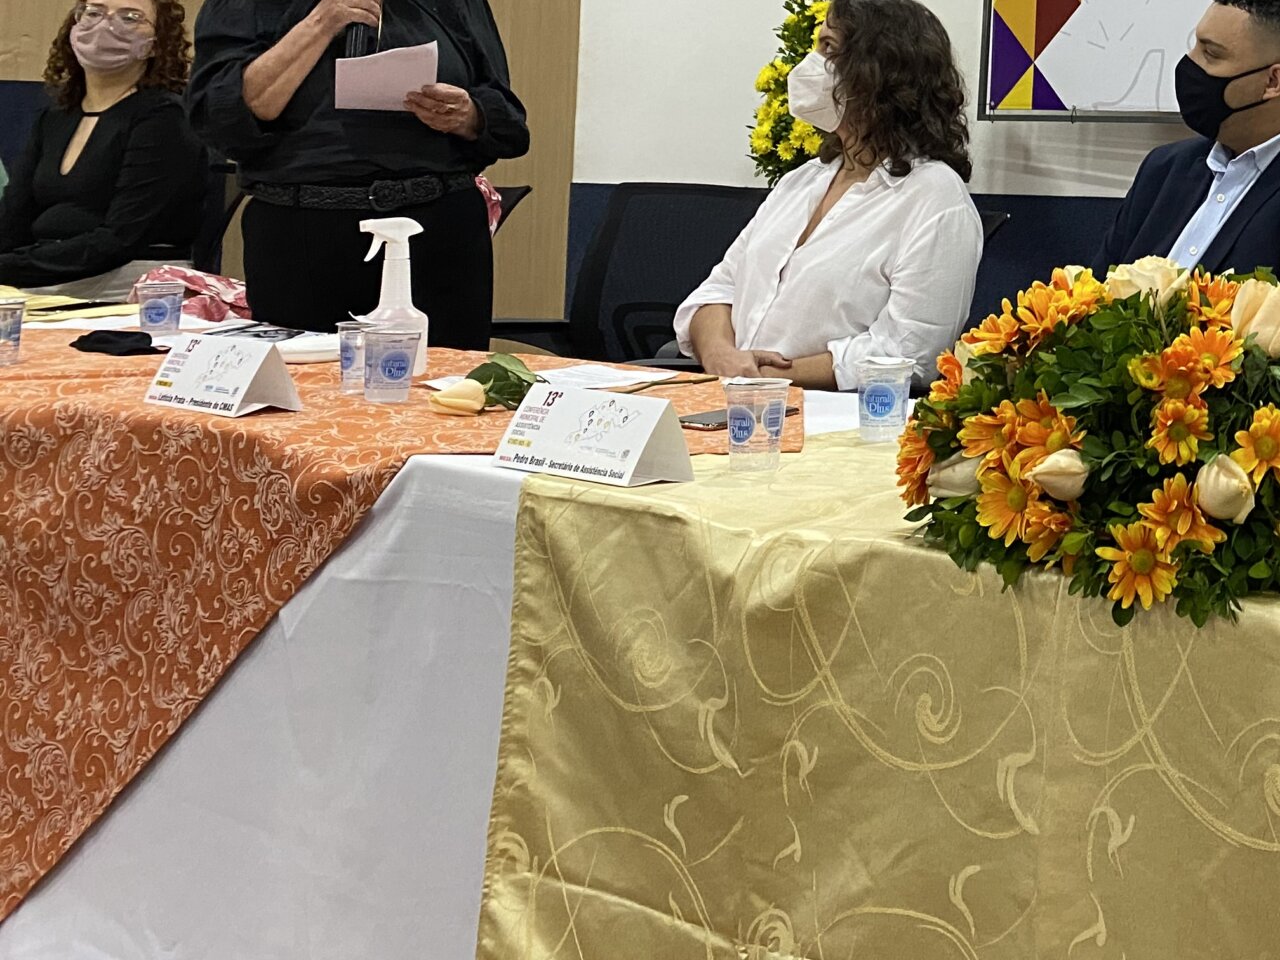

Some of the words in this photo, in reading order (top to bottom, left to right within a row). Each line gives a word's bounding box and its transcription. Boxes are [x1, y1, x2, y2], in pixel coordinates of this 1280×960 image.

[870, 402, 891, 414] Plus
[512, 453, 529, 465] Pedro
[528, 456, 546, 468] Brasil
[608, 468, 626, 480] Social
